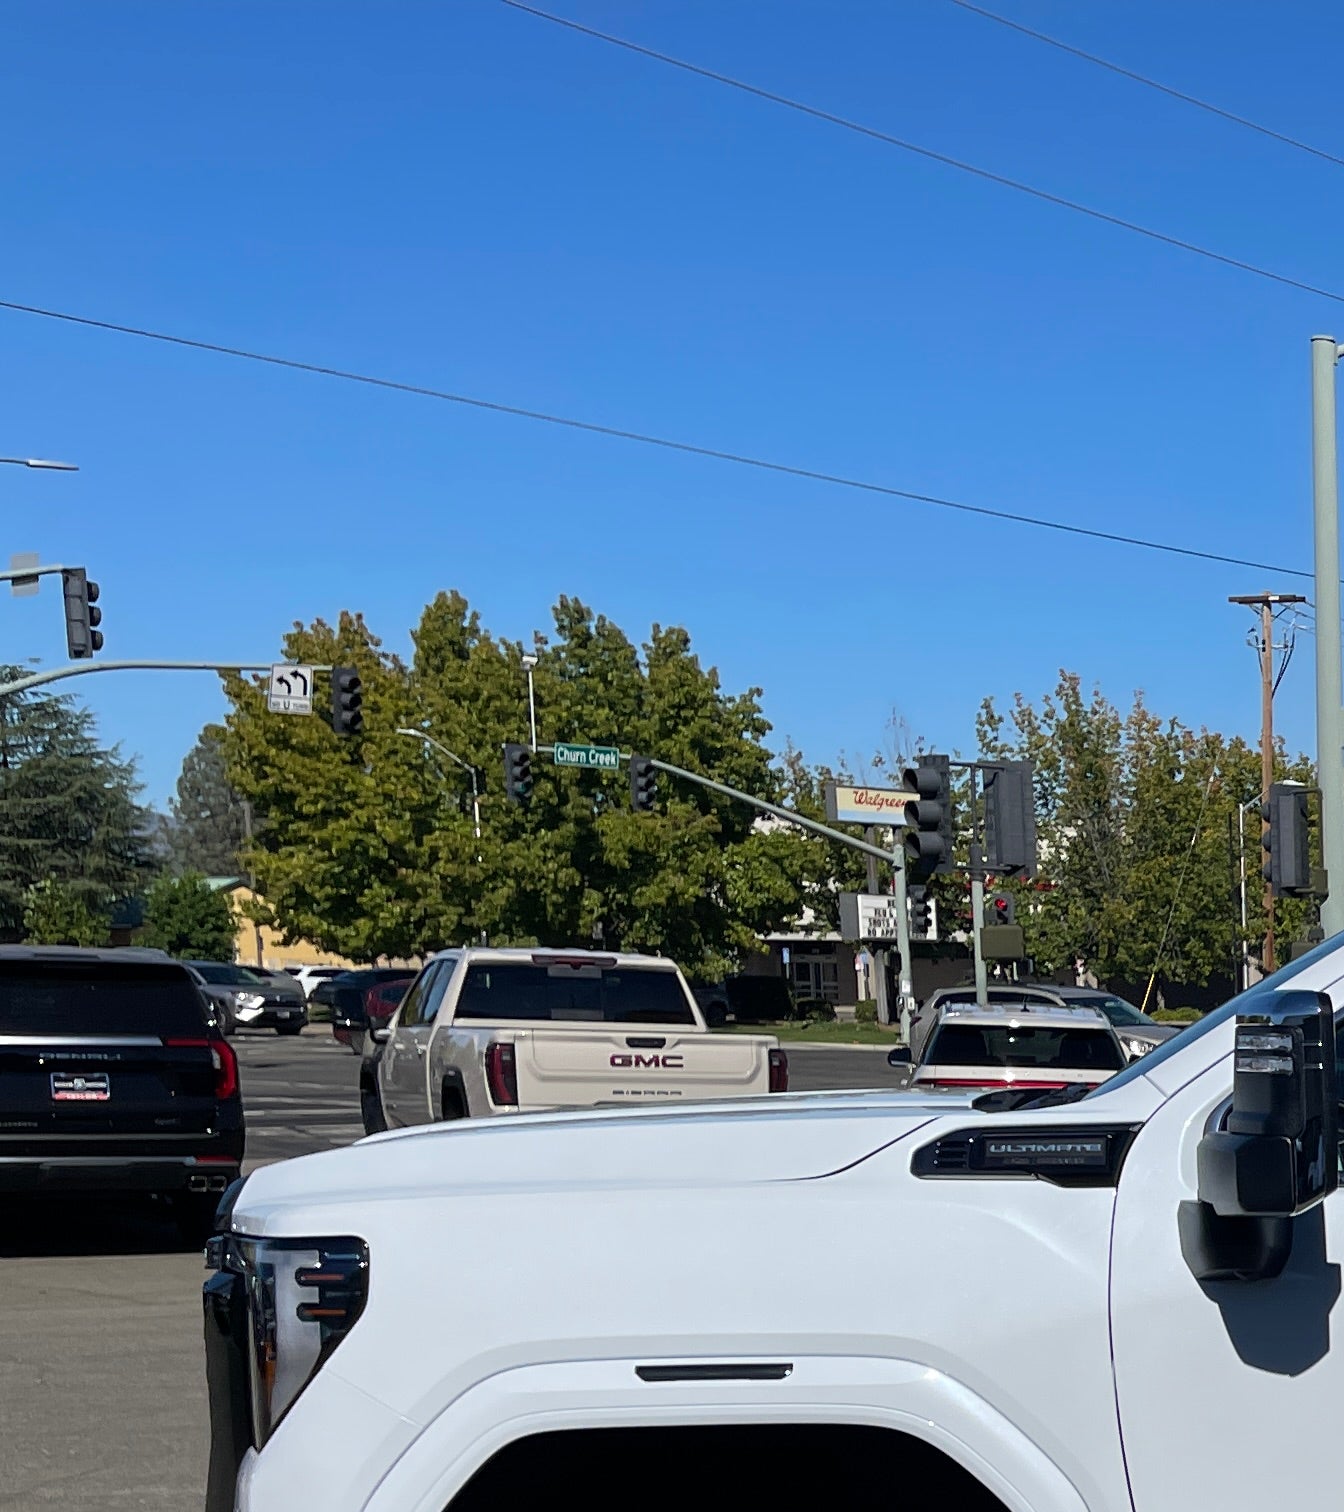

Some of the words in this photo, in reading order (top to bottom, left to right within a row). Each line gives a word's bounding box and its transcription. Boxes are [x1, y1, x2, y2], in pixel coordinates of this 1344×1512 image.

[557, 746, 586, 764] Churn
[589, 748, 616, 766] Creek
[853, 790, 908, 812] Walgree
[609, 1053, 684, 1068] GMC
[990, 1143, 1101, 1153] ULTIMATE
